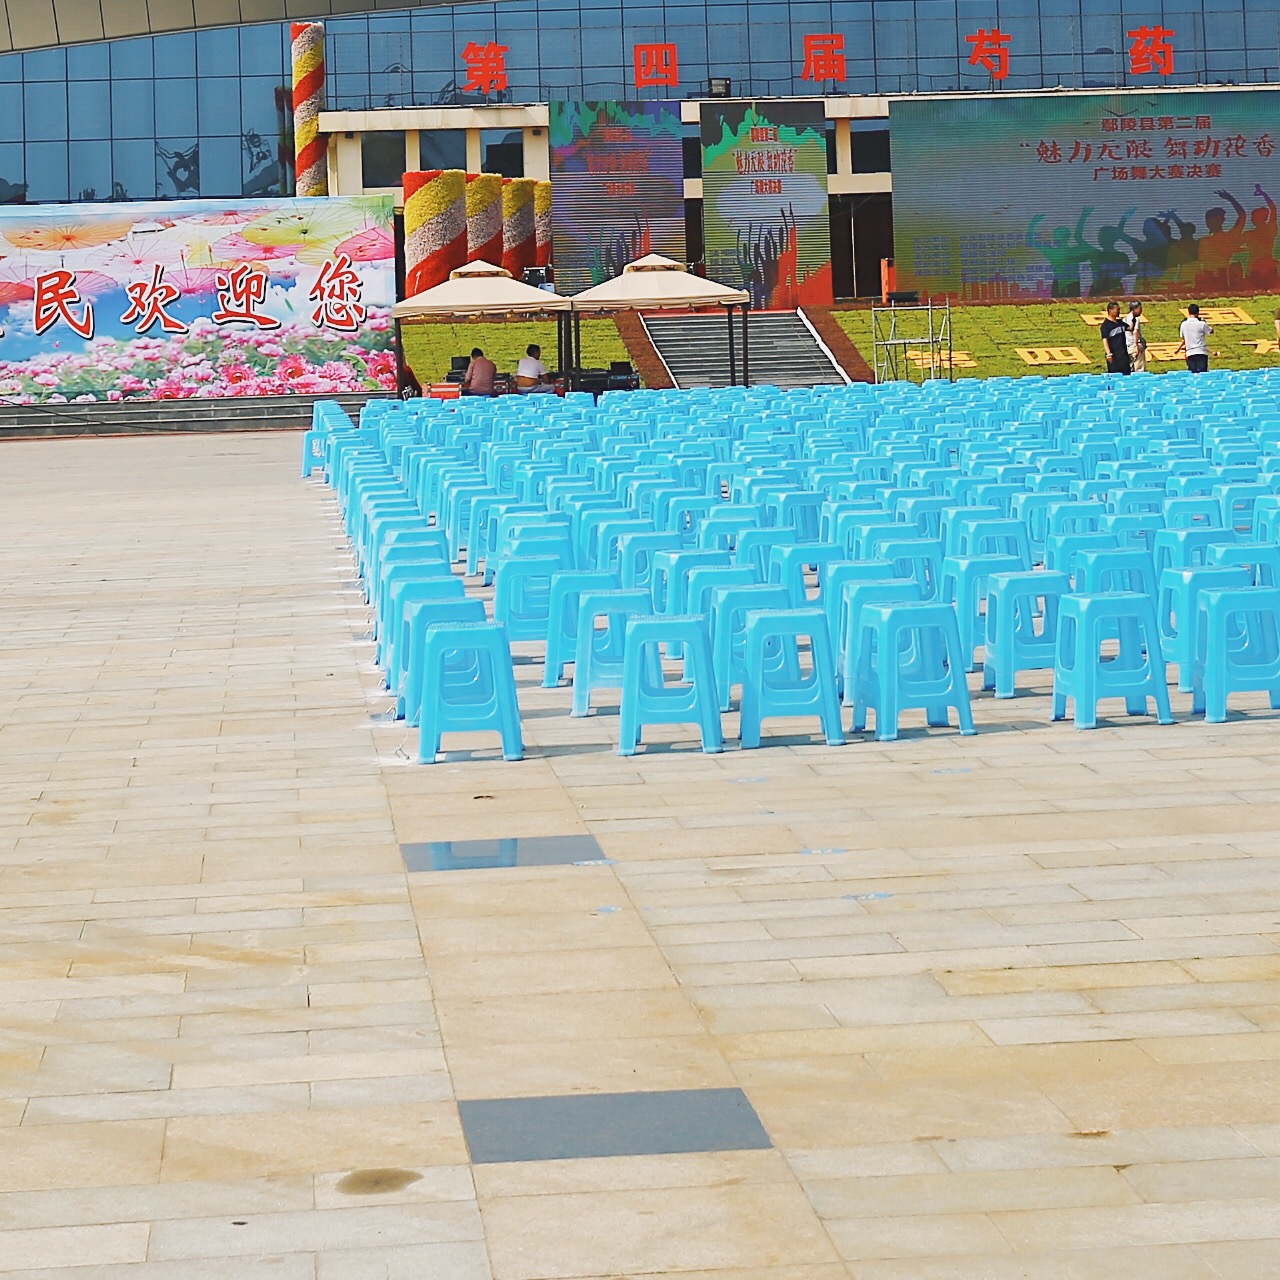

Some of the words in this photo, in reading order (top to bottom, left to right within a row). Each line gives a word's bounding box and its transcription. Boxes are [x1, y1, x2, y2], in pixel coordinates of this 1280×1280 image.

[1101, 115, 1212, 132] 鄢陵县第二届
[1093, 164, 1222, 181] 广场舞大赛决赛
